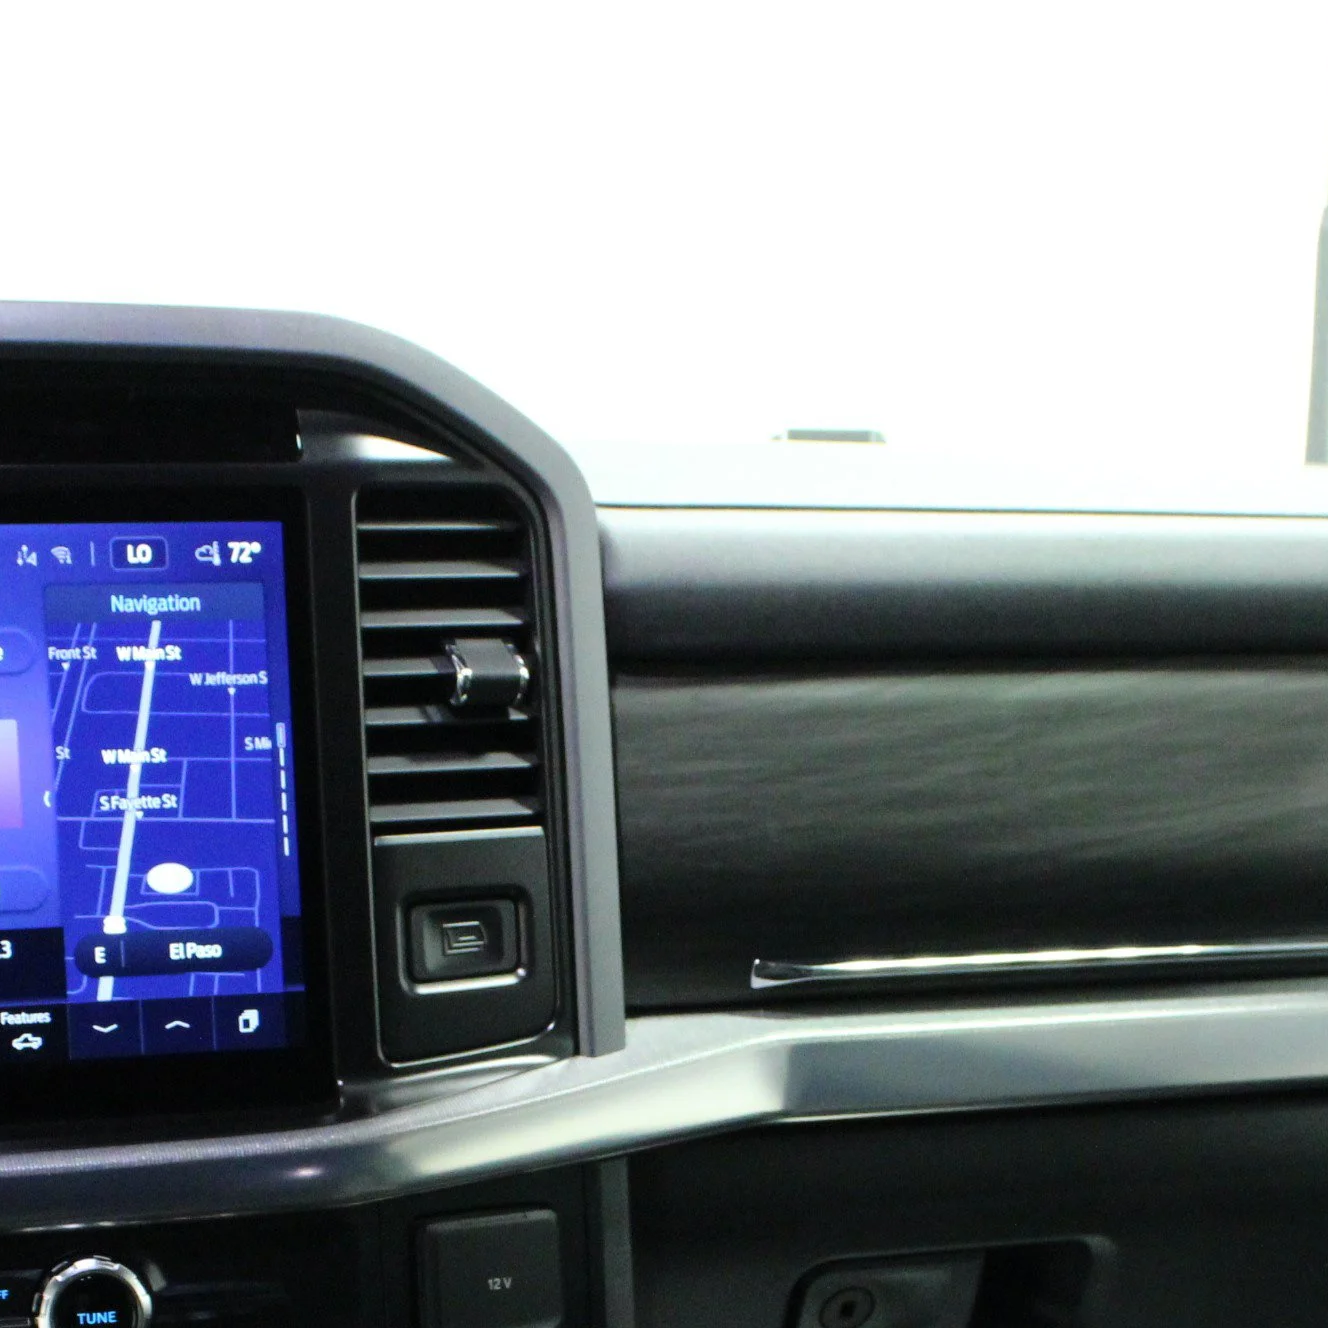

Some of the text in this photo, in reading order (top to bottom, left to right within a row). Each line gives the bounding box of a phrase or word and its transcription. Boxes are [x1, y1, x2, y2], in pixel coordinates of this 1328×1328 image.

[126, 544, 153, 564] LO
[110, 594, 202, 615] Navigation
[48, 645, 98, 660] Front St
[116, 646, 133, 662] W
[165, 644, 182, 661] St
[189, 673, 204, 687] W
[204, 671, 258, 686] Jefferson
[55, 746, 70, 760] St
[101, 749, 118, 765] W
[150, 747, 167, 763] St
[100, 796, 110, 811] S
[161, 794, 177, 809] St
[94, 946, 106, 964] E
[169, 942, 223, 961] El Paso
[0, 1011, 51, 1027] Features
[77, 1310, 117, 1326] TUNE
